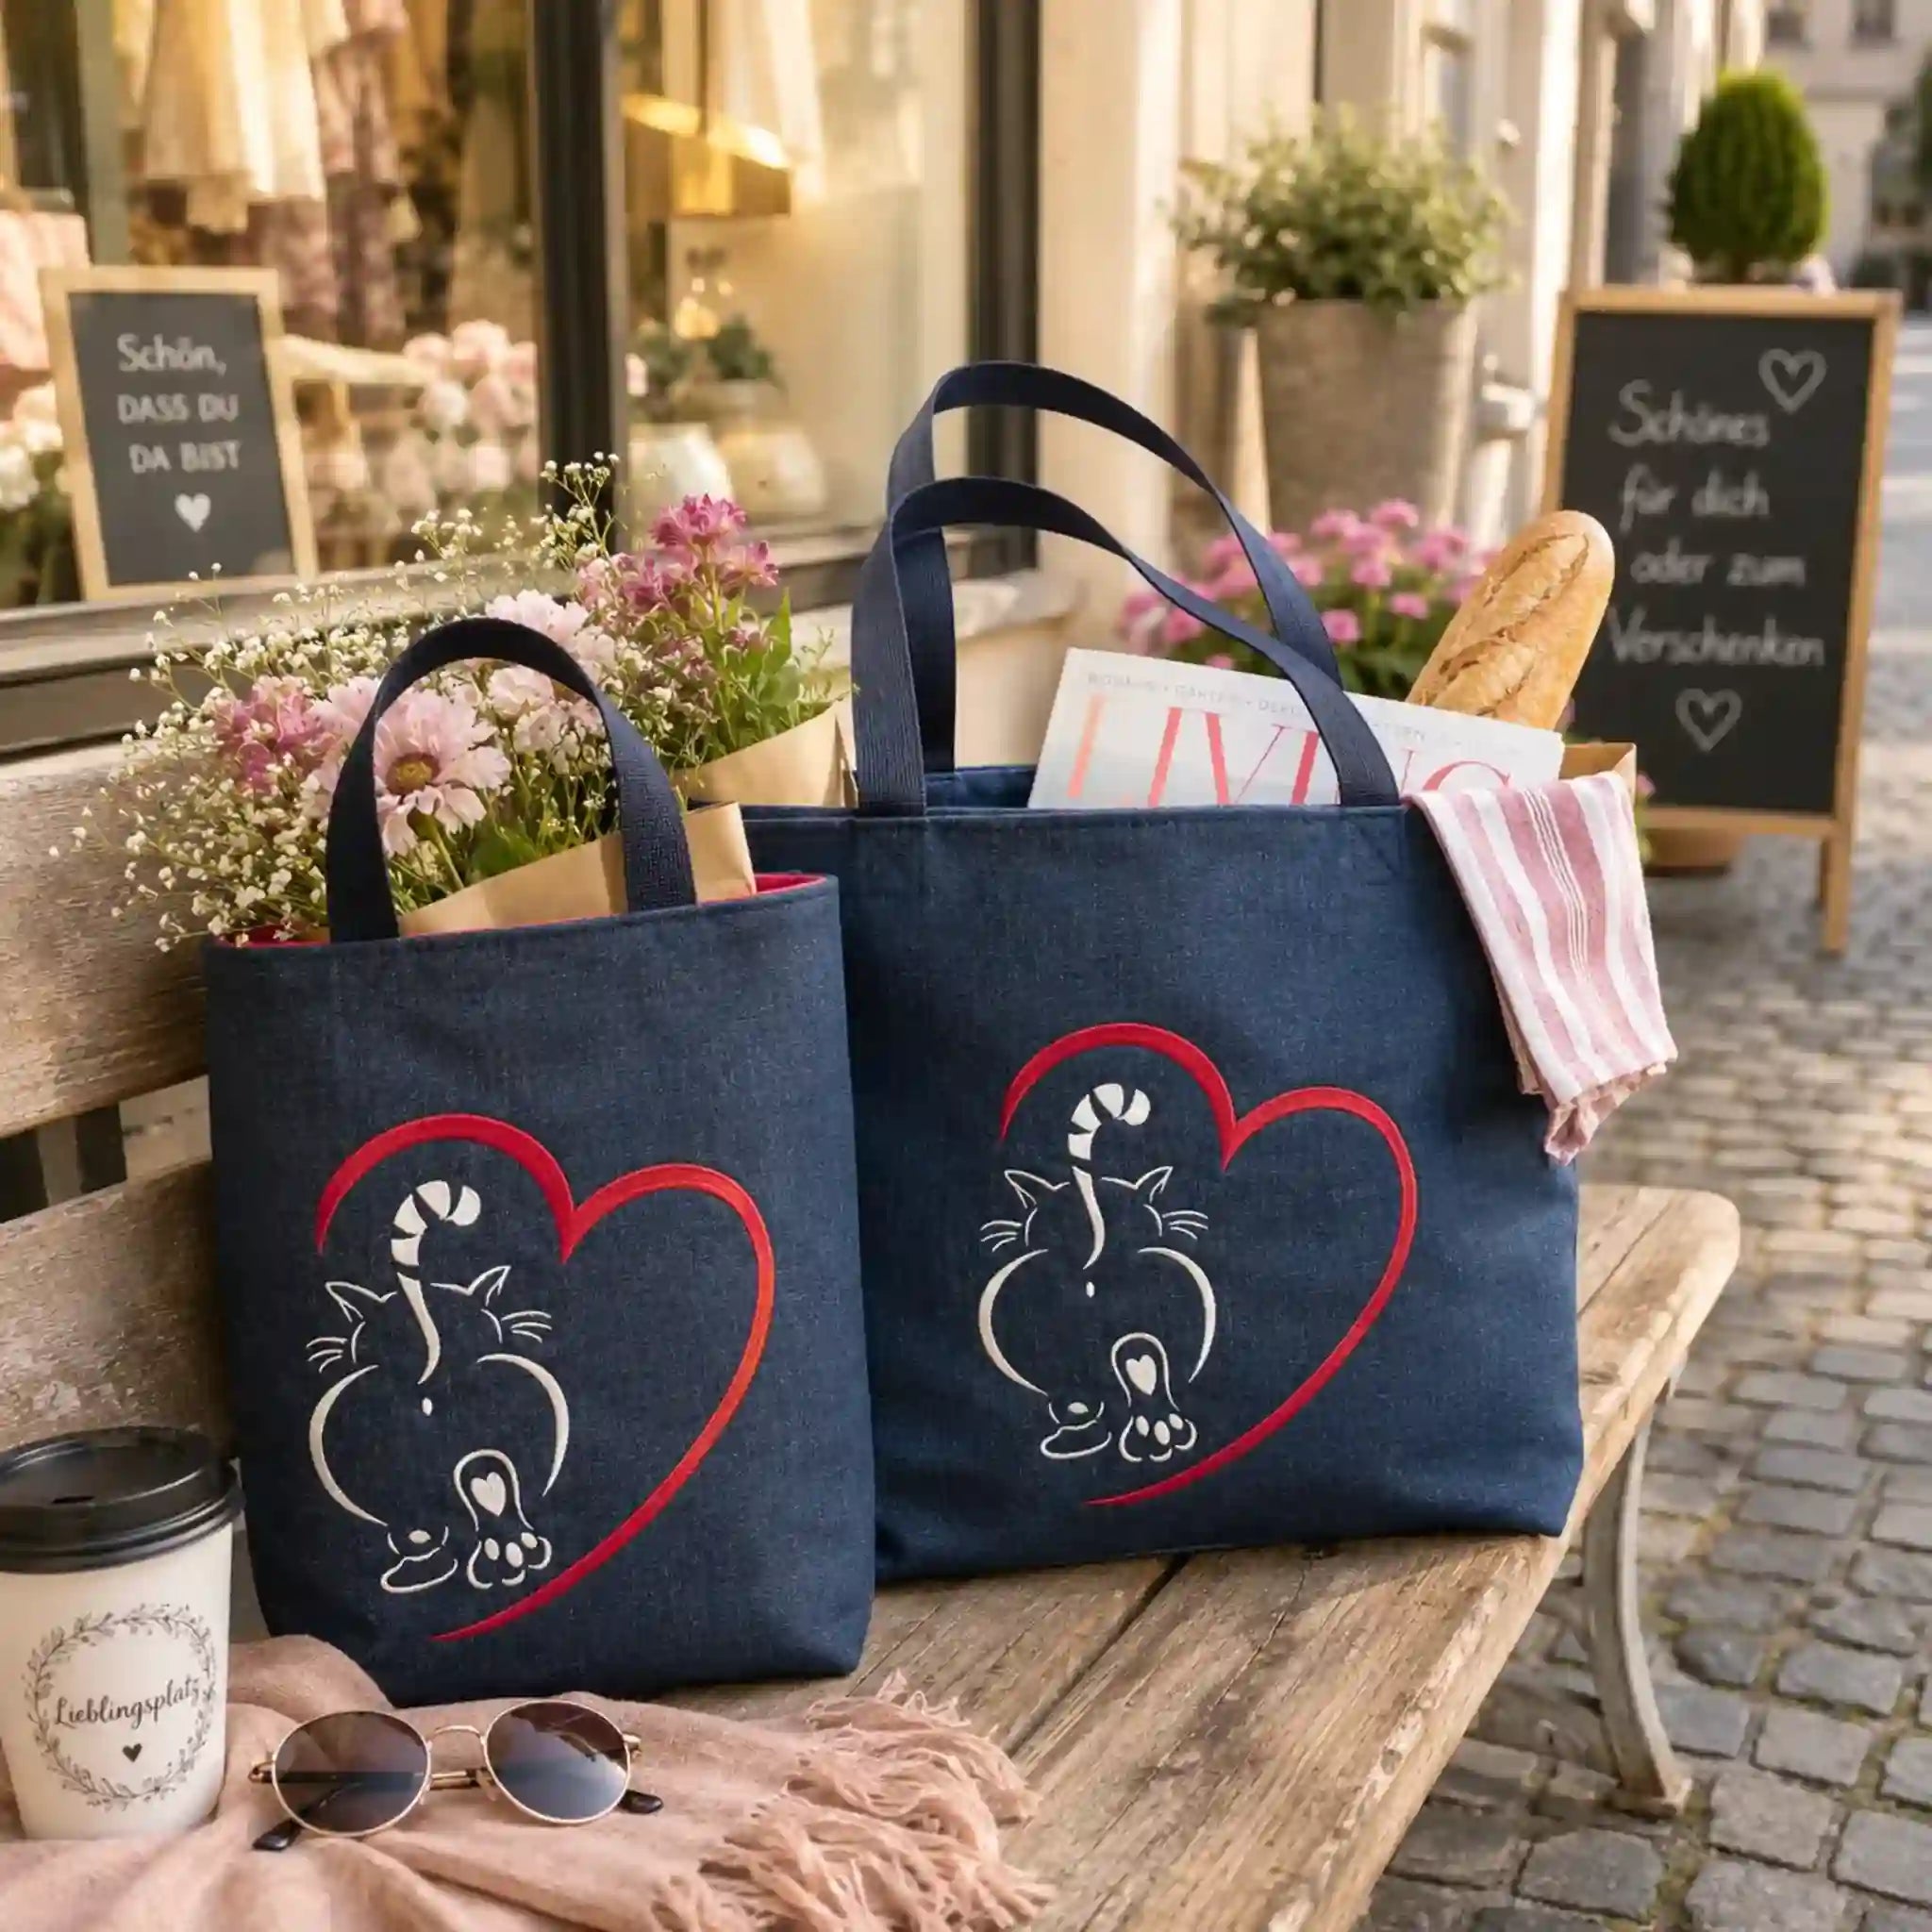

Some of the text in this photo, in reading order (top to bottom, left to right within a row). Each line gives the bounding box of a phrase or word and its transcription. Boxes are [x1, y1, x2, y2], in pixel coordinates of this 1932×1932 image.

[117, 393, 240, 424] DASS DU
[128, 440, 242, 474] DA BIST
[1692, 467, 1771, 517] dich
[1630, 536, 1713, 584] oder
[54, 1674, 201, 1730] Lieblingsplatz
